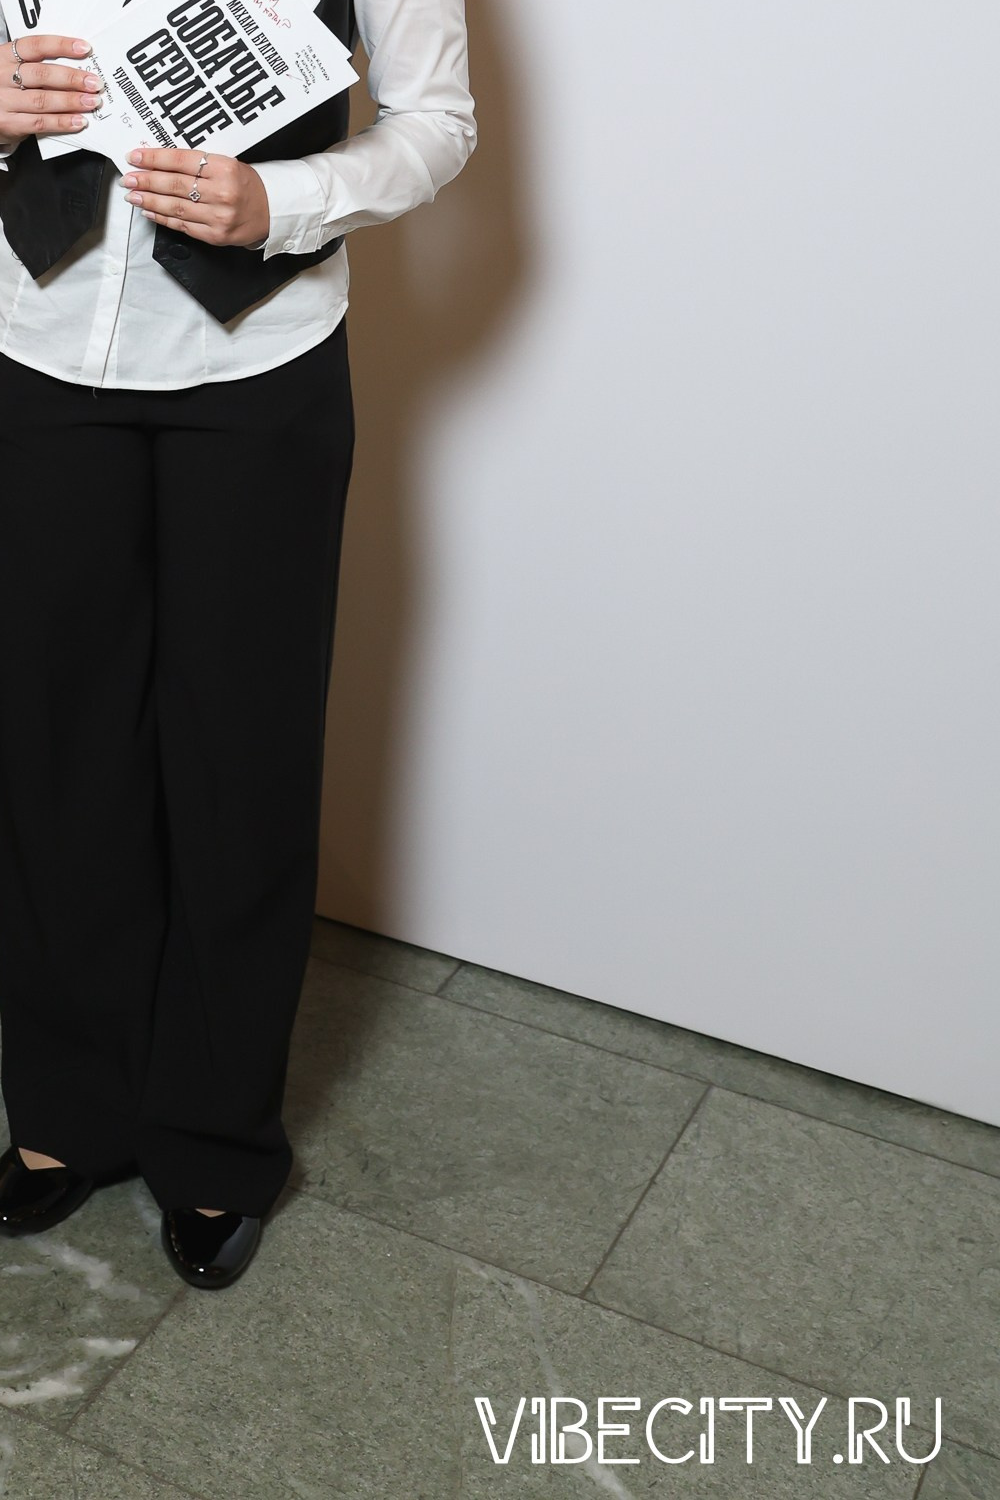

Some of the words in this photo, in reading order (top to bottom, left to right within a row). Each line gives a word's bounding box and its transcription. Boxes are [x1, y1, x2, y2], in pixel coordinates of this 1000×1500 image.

[251, 32, 290, 76] БУЛГАКОВ
[112, 66, 154, 121] ЧУДОВИЩНАЯ
[126, 28, 234, 149] СЕРДЦЕ
[120, 112, 133, 129] 16+
